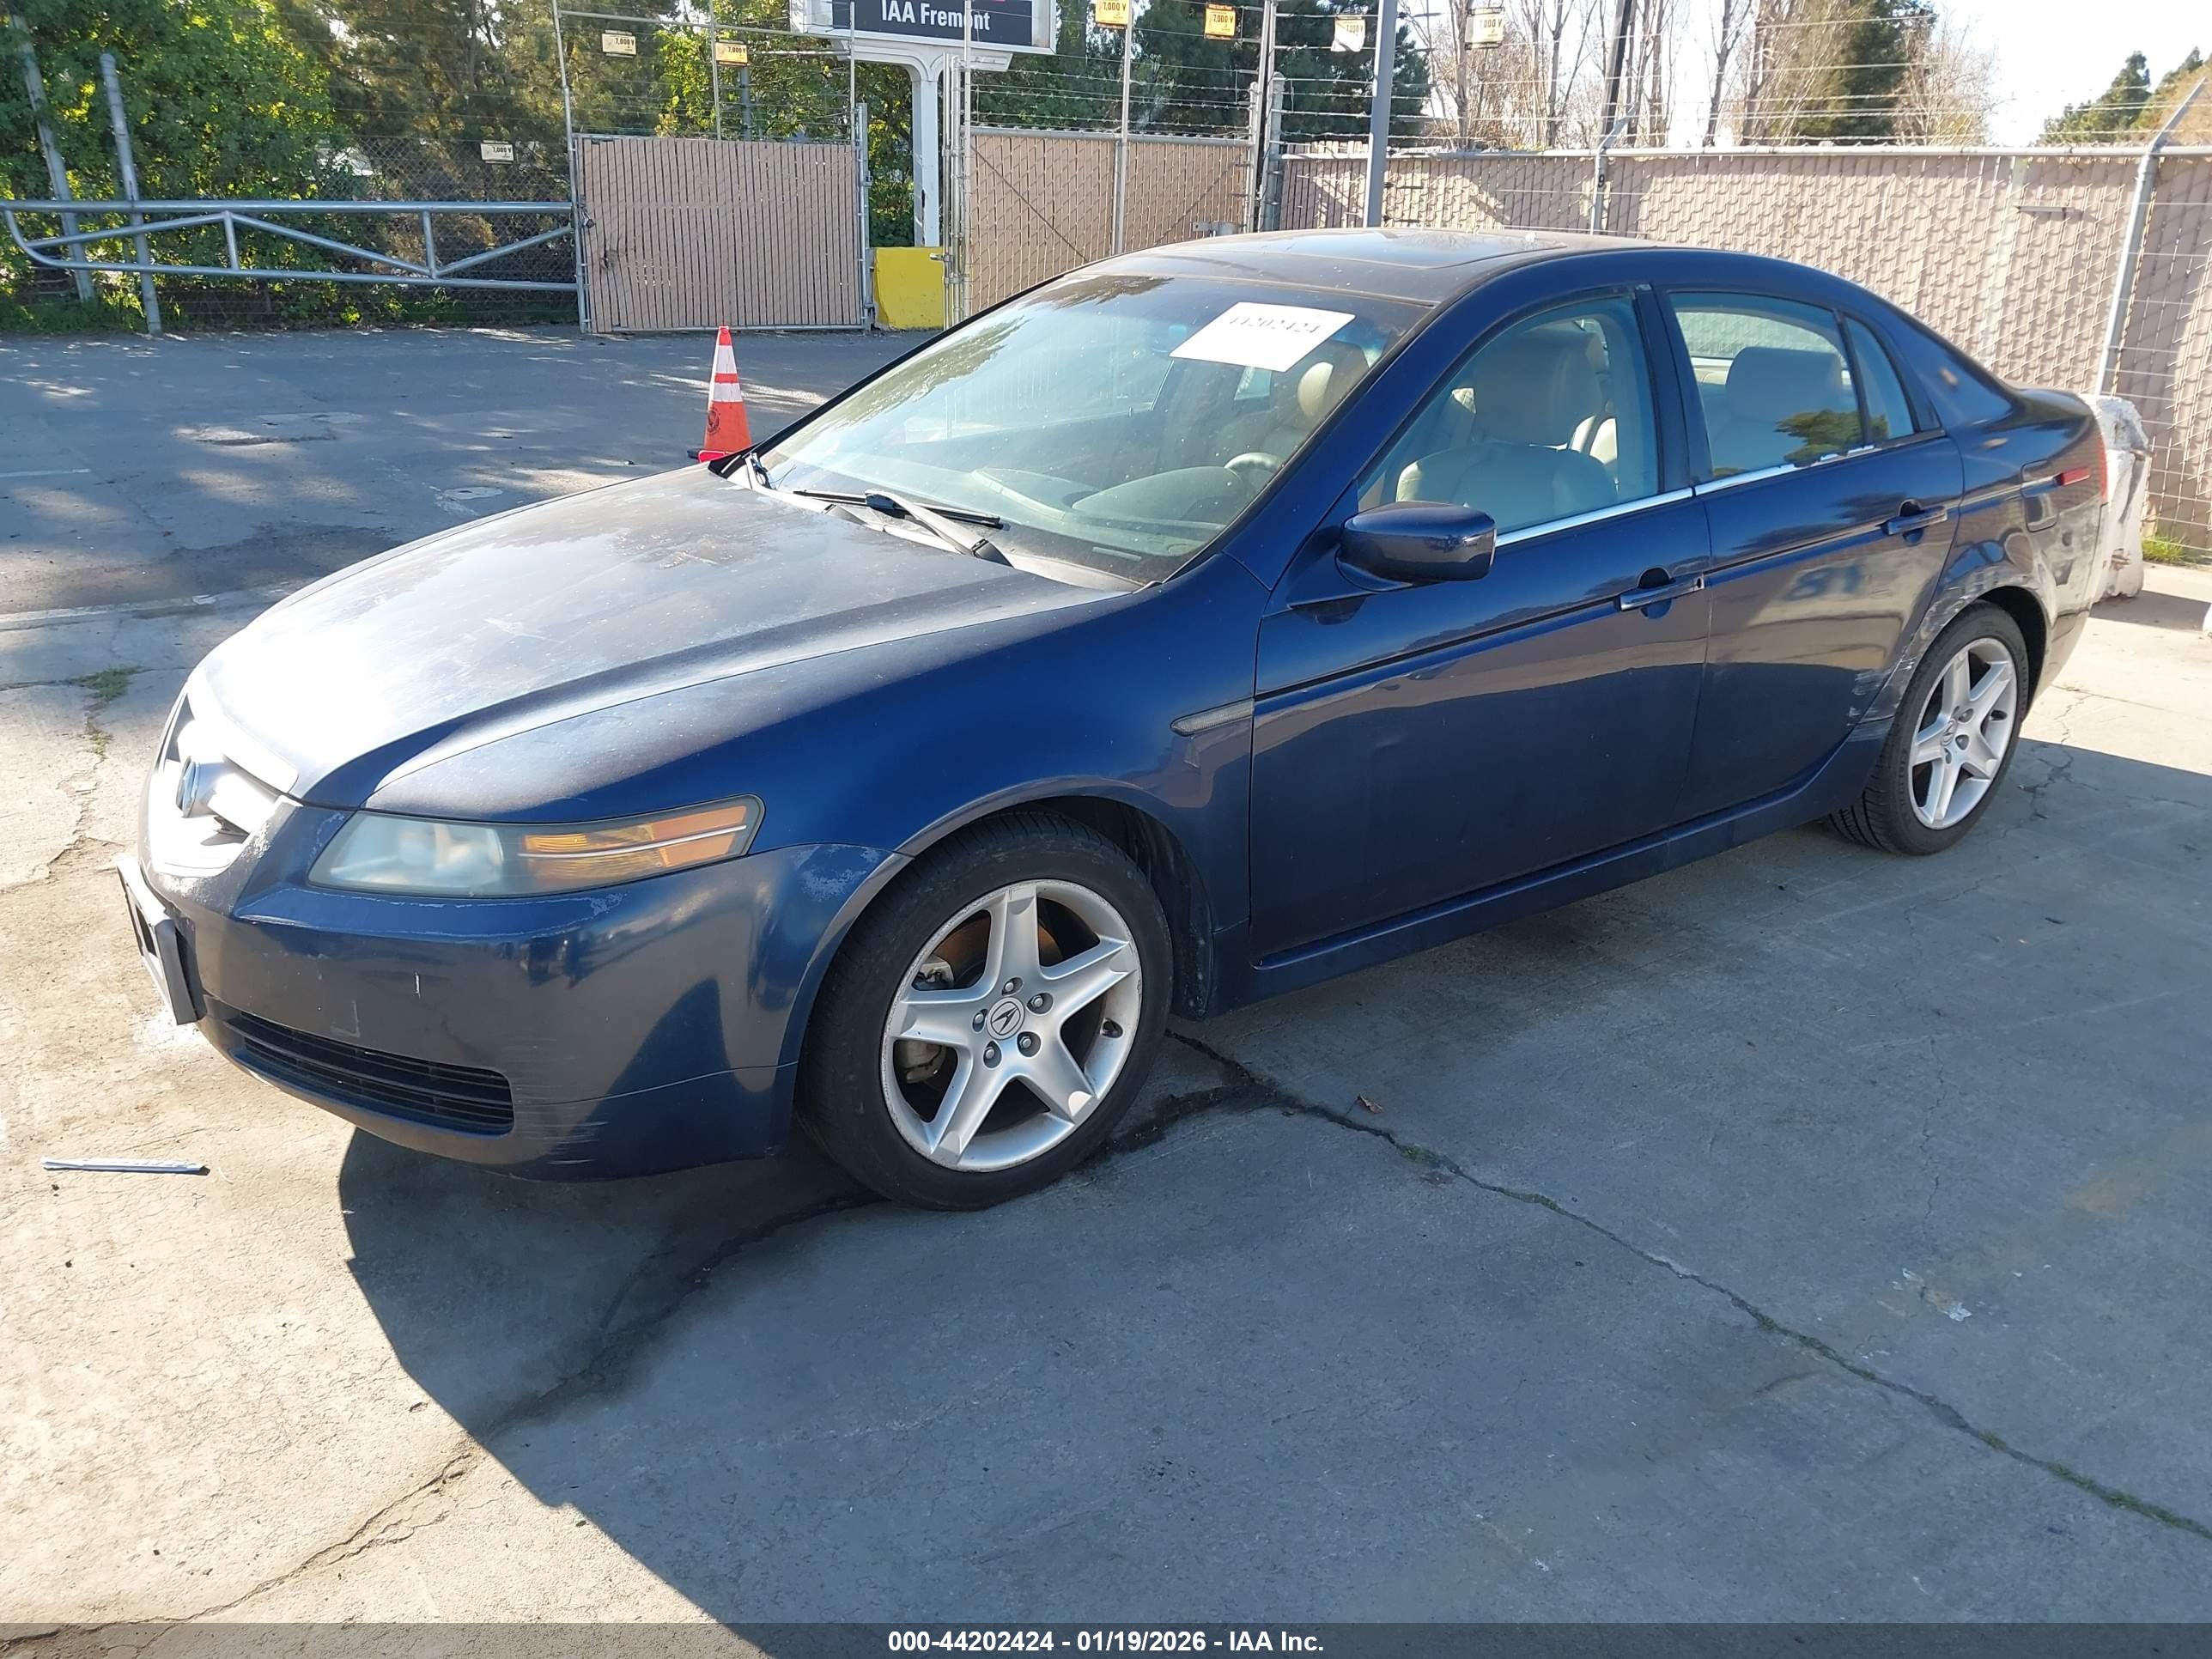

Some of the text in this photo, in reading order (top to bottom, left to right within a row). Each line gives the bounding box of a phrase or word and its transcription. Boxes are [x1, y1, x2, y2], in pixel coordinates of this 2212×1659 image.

[881, 0, 915, 23] IAA
[1103, 2, 1127, 11] 7,000 V
[1212, 14, 1234, 24] 7,000 V
[1498, 18, 1503, 28] V
[615, 37, 630, 46] 7,000
